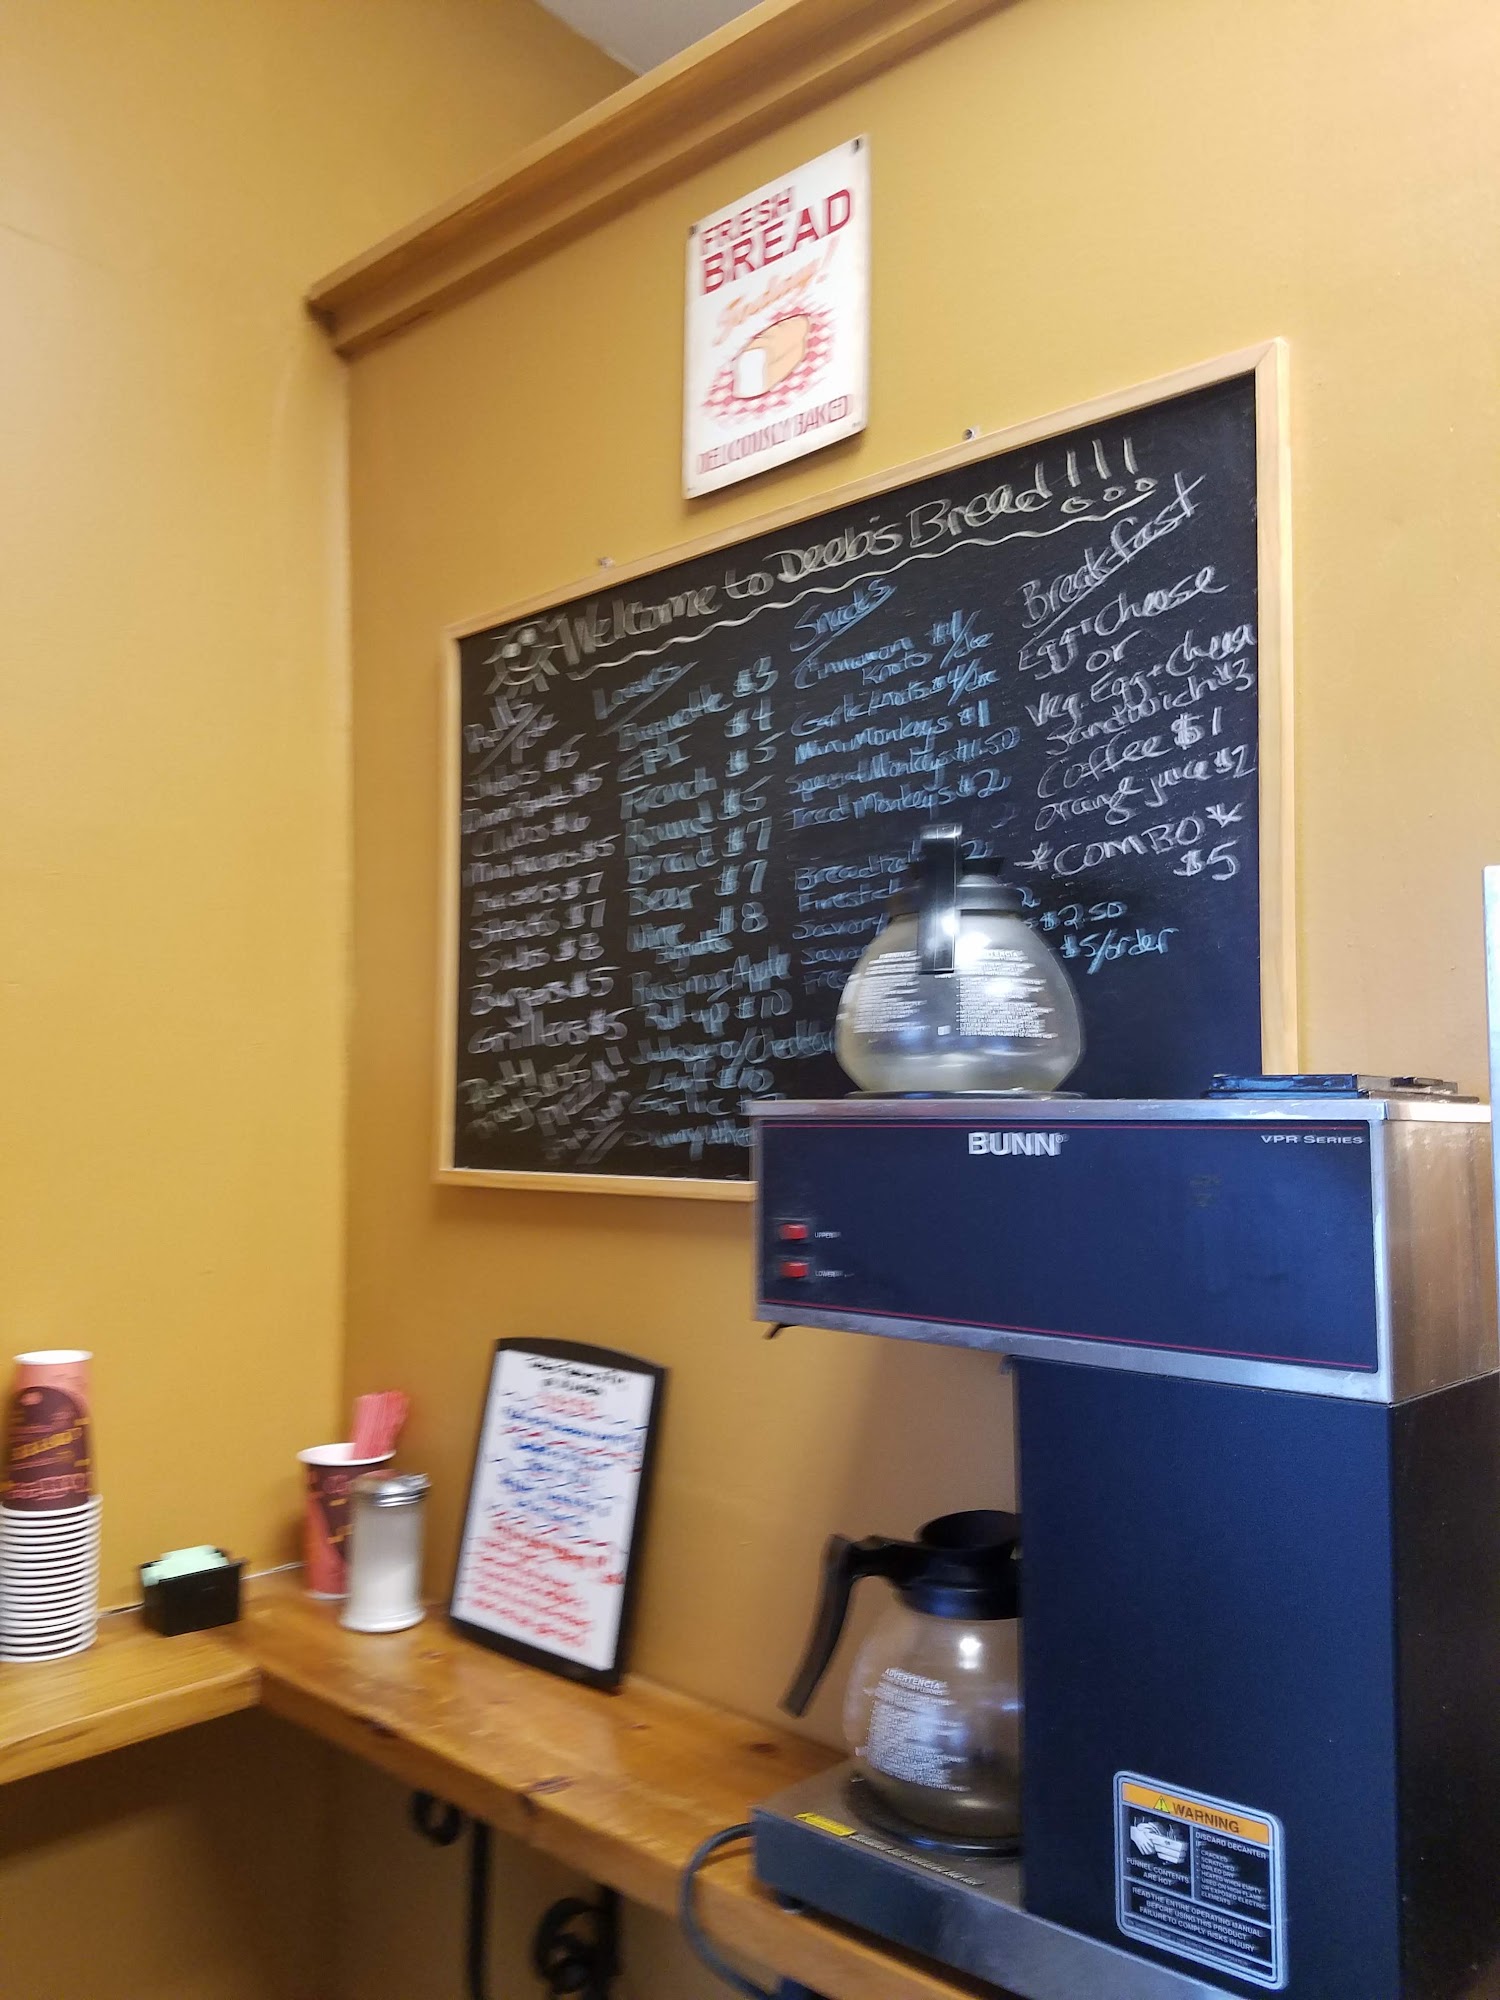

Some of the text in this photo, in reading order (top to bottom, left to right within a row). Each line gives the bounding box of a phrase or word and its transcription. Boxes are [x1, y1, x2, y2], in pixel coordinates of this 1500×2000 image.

[701, 186, 795, 247] FRESH
[701, 189, 852, 296] BREAD
[1018, 471, 1206, 629] Breakfast
[558, 582, 721, 666] Welcome
[723, 569, 773, 600] to
[1086, 630, 1142, 672] or
[958, 699, 990, 728] $1
[1037, 706, 1222, 798] Coffee $1
[1214, 744, 1256, 778] $2
[1173, 840, 1239, 881] $5
[968, 1132, 1060, 1156] BUNN
[1261, 1134, 1299, 1144] VPR
[884, 1668, 941, 1690] ADVERTENCIA
[1172, 1802, 1240, 1833] WARNING
[1195, 1832, 1268, 1860] DISCARD DECANTER
[1200, 1850, 1230, 1863] CRACKED
[1126, 1857, 1190, 1885] FUNNEL CONTENTS
[1201, 1857, 1237, 1872] SCRATCHED
[1201, 1864, 1219, 1876] BOILED
[1143, 1871, 1173, 1887] ARE HOT
[1201, 1871, 1263, 1895] HEATED WHEN EMPTY
[1201, 1878, 1217, 1889] USED
[1227, 1885, 1242, 1896] HIGH
[1243, 1889, 1265, 1902] FLAME
[1132, 1887, 1150, 1900] READ
[1151, 1892, 1165, 1904] THE
[1166, 1896, 1190, 1912] ENTIRE
[1191, 1904, 1231, 1927] OPERATING
[1232, 1919, 1262, 1938] MANUAL
[1201, 1892, 1231, 1907] ELEMENTS
[1210, 1887, 1237, 1902] EXPOSED
[1238, 1895, 1269, 1911] ELECTRIC
[1139, 1906, 1166, 1922] FAILURE
[1165, 1913, 1177, 1925] TO
[1177, 1920, 1206, 1937] COMPLY
[1207, 1931, 1228, 1947] RISKS
[1229, 1937, 1256, 1954] INJURY
[1146, 1900, 1173, 1917] BEFORE
[1174, 1909, 1196, 1924] USING
[1196, 1916, 1212, 1930] THIS
[1213, 1922, 1247, 1941] PRODUCT
